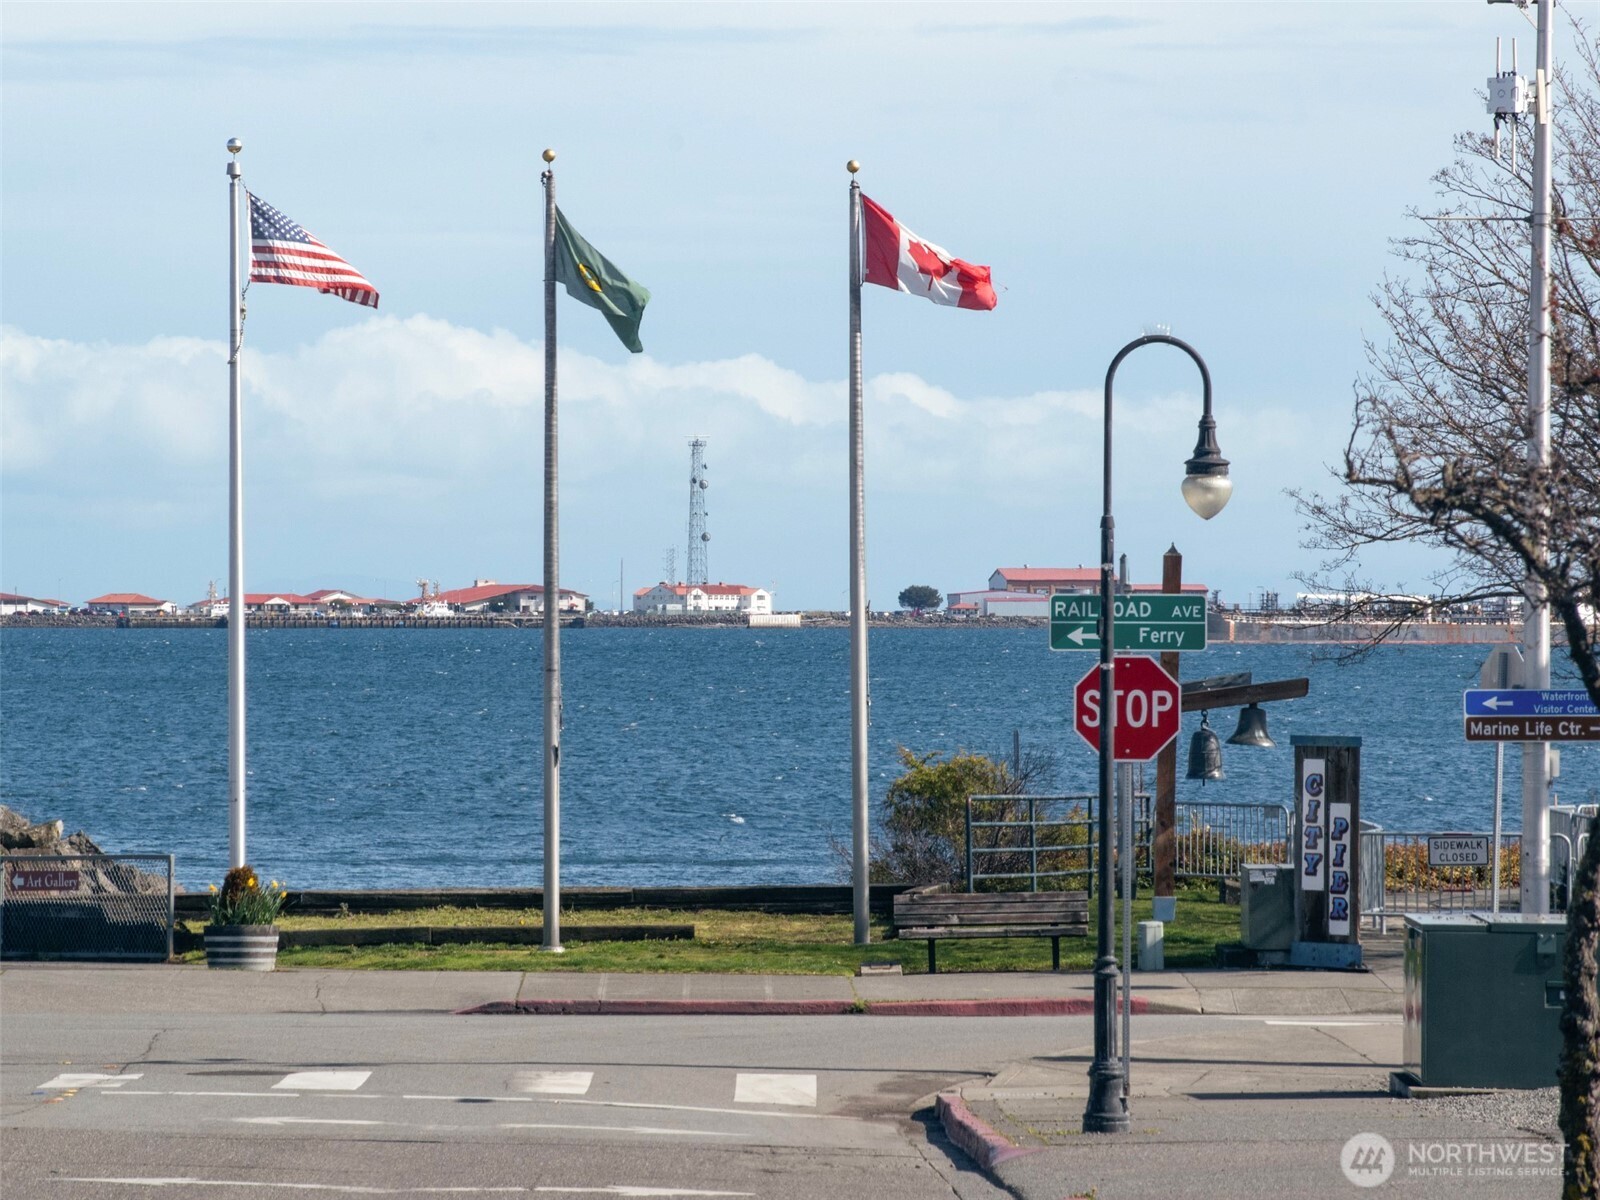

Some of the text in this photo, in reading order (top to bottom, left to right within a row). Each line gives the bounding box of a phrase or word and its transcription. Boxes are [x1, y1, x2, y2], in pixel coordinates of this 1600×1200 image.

[1055, 602, 1201, 618] RAILOAD AVE
[1139, 628, 1185, 646] Ferry
[1541, 692, 1589, 701] Waterfront
[1533, 704, 1597, 714] Visitor Center
[1470, 721, 1586, 736] Marine Life Ctr.
[1304, 773, 1323, 876] CITY
[1433, 840, 1483, 850] SIDEWALK
[1439, 853, 1478, 862] CLOSED
[1330, 817, 1349, 920] PIER
[26, 872, 78, 890] Art Gallery
